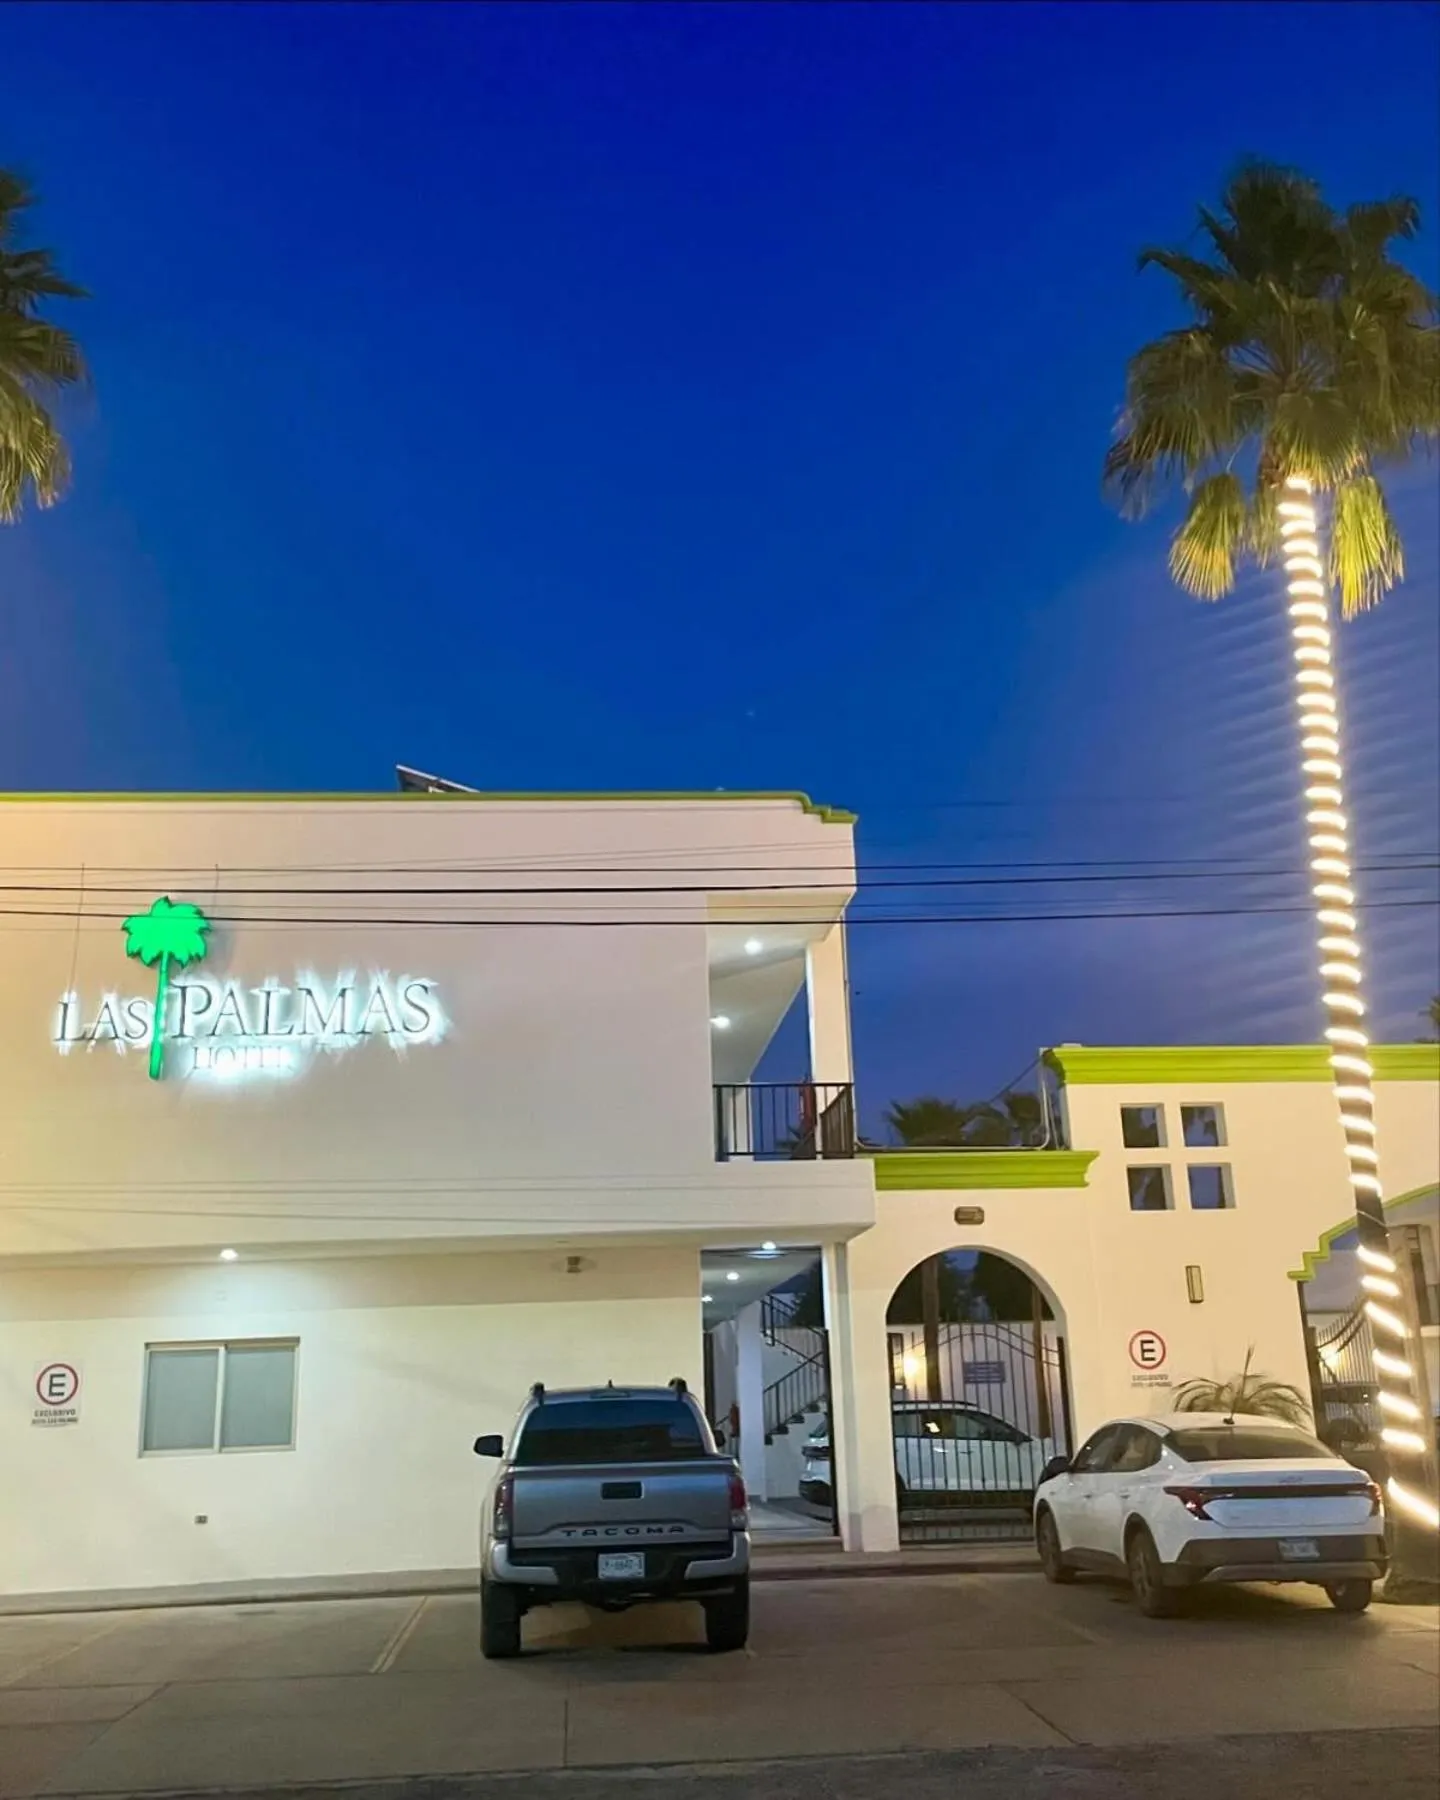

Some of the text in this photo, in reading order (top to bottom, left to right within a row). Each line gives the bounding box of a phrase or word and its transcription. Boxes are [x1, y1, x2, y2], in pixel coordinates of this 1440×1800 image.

[54, 983, 435, 1041] LAS PALMAS
[1140, 1339, 1156, 1361] E
[48, 1373, 66, 1396] E
[562, 1526, 686, 1537] TACOMA
